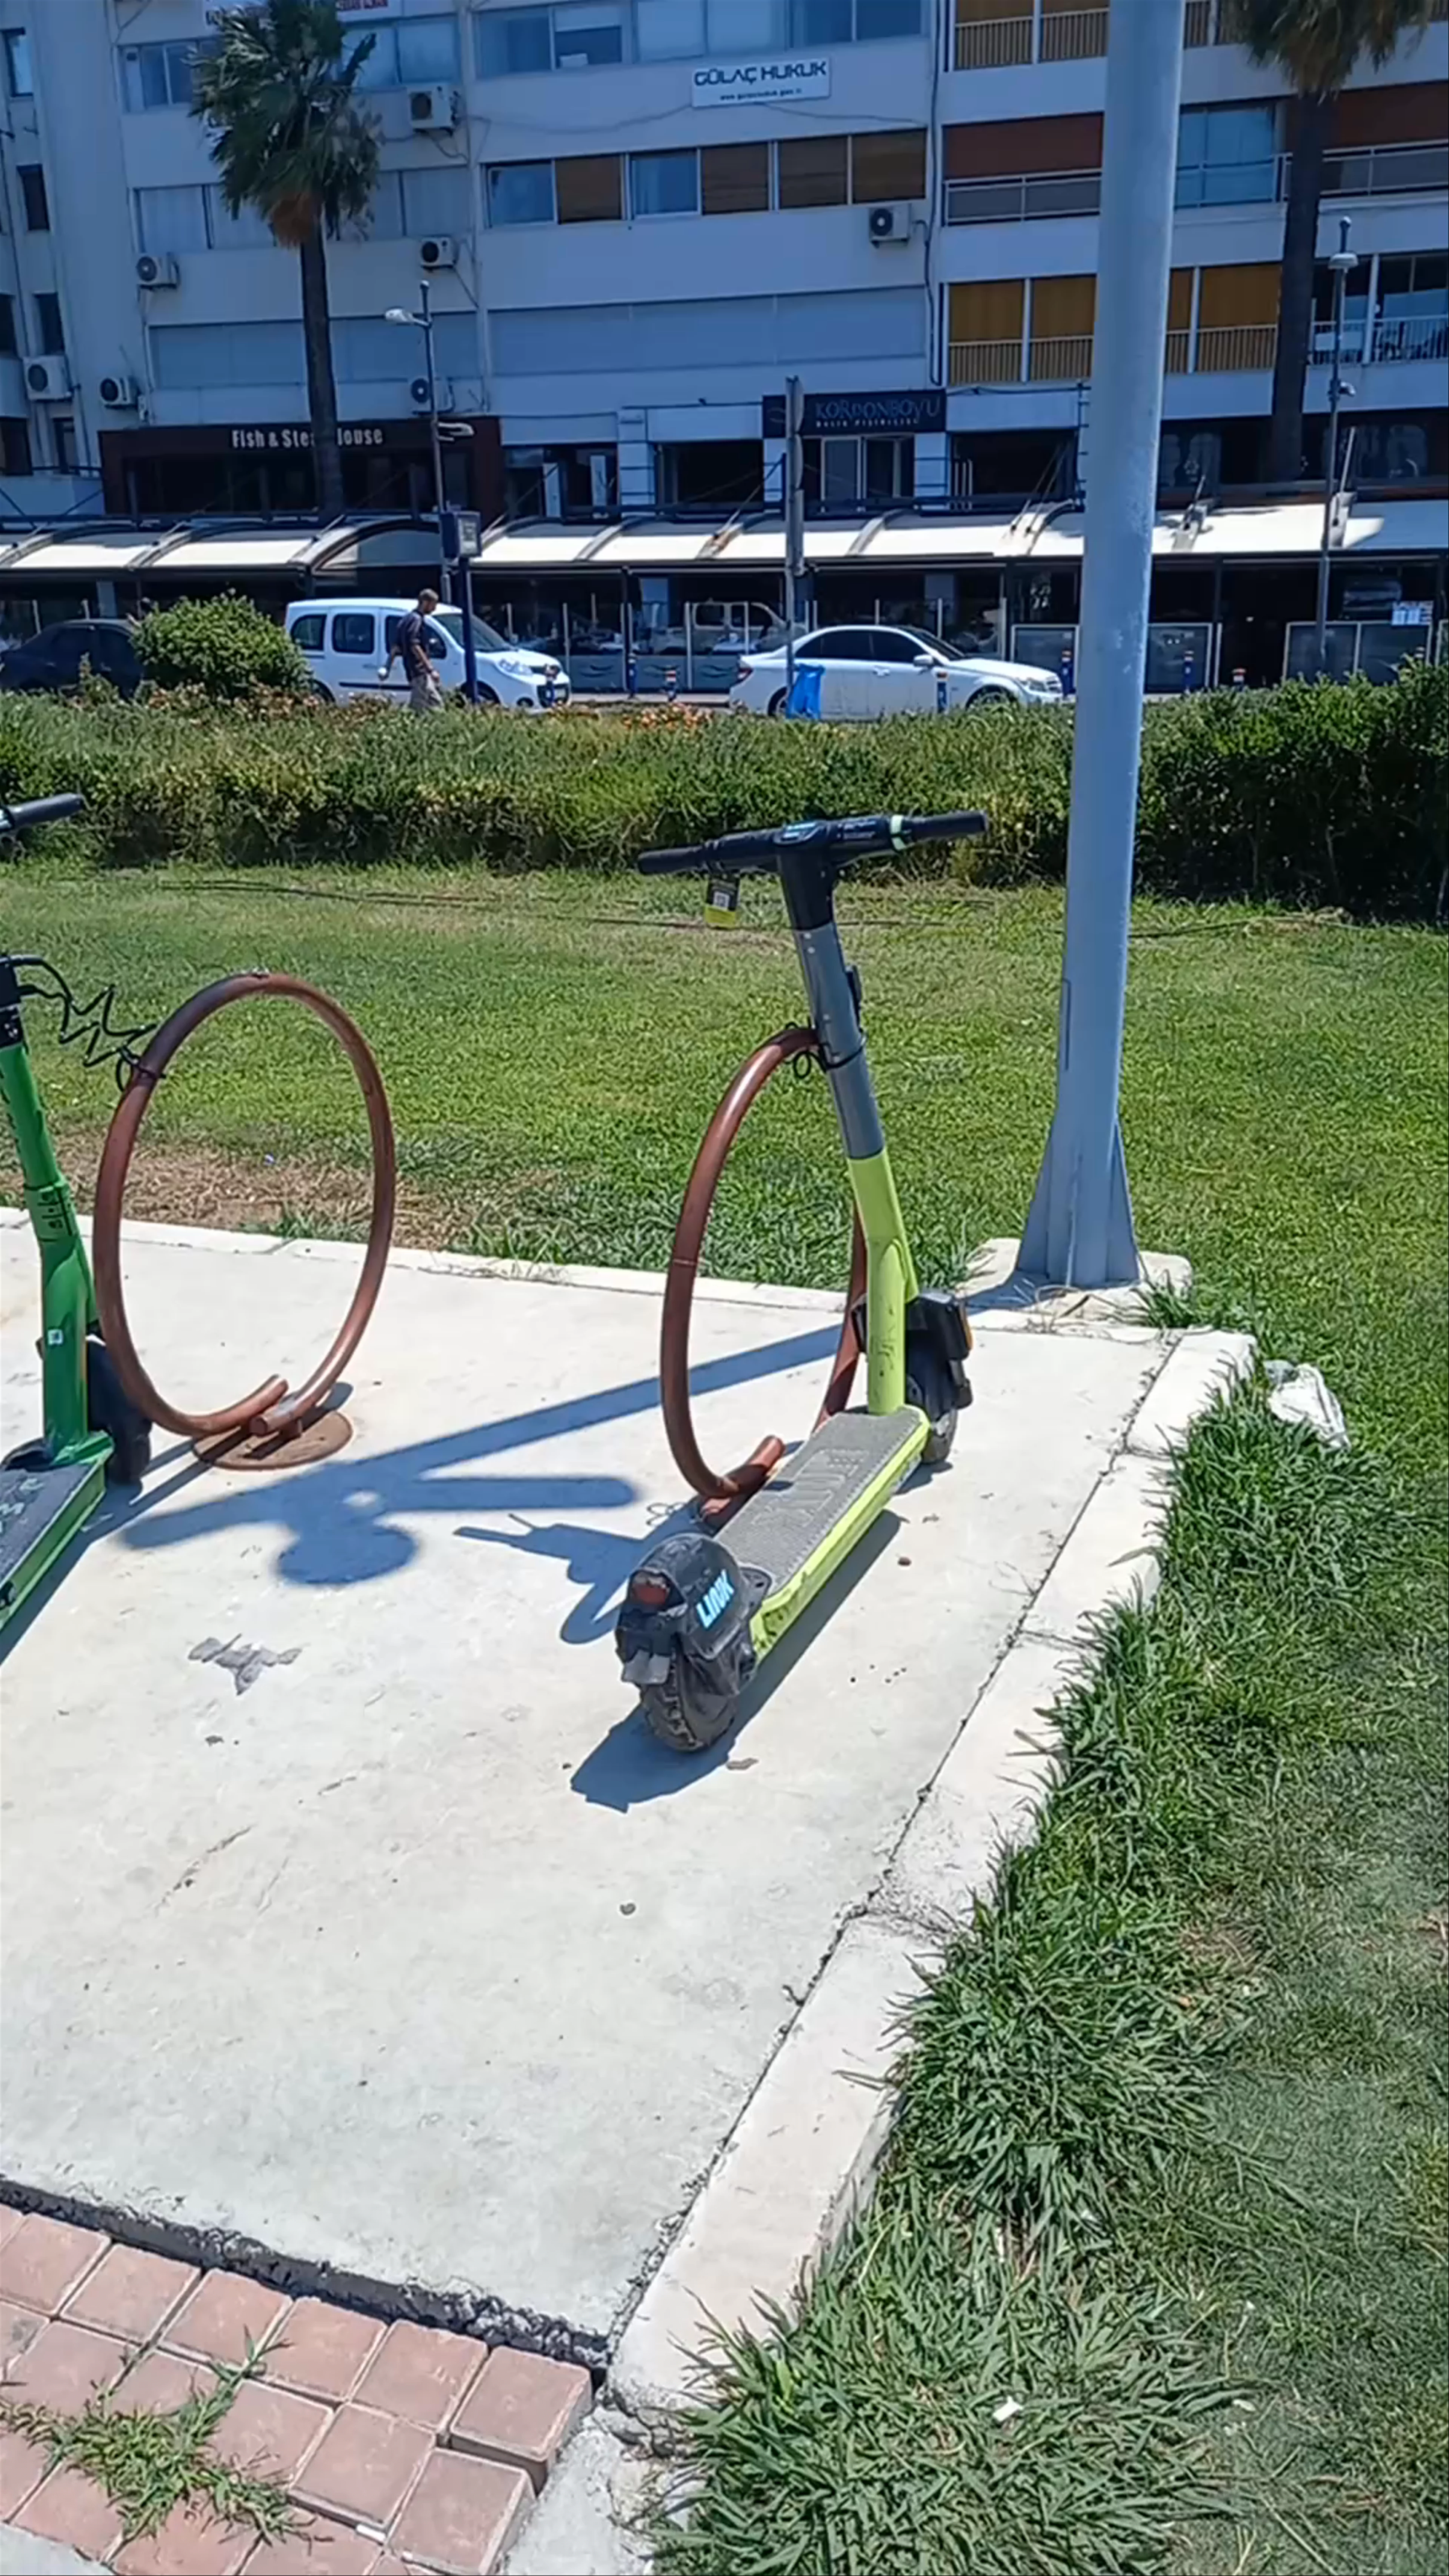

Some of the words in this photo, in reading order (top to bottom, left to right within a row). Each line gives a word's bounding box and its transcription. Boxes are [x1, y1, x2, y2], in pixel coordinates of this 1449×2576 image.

[694, 67, 757, 86] GÜLAÇ
[761, 61, 826, 80] HUKUK
[232, 429, 265, 448] Fish
[268, 431, 279, 447] &
[696, 1569, 734, 1629] LINK
